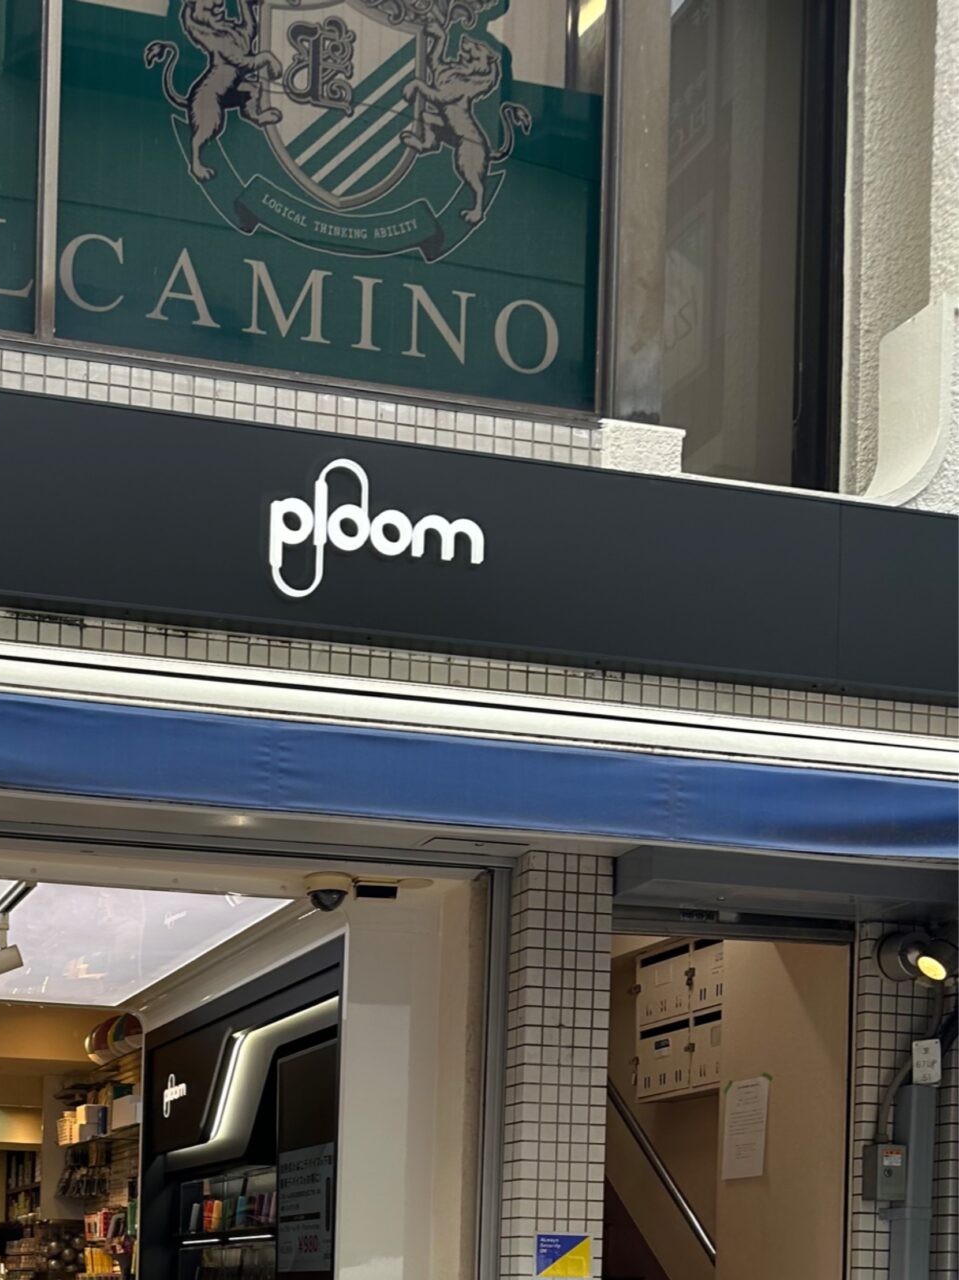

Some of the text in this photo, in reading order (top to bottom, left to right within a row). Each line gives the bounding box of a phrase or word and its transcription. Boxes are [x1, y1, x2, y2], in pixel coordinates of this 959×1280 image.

[262, 193, 418, 239] LOGICAL THINKING ABILITY
[269, 458, 485, 598] ploom
